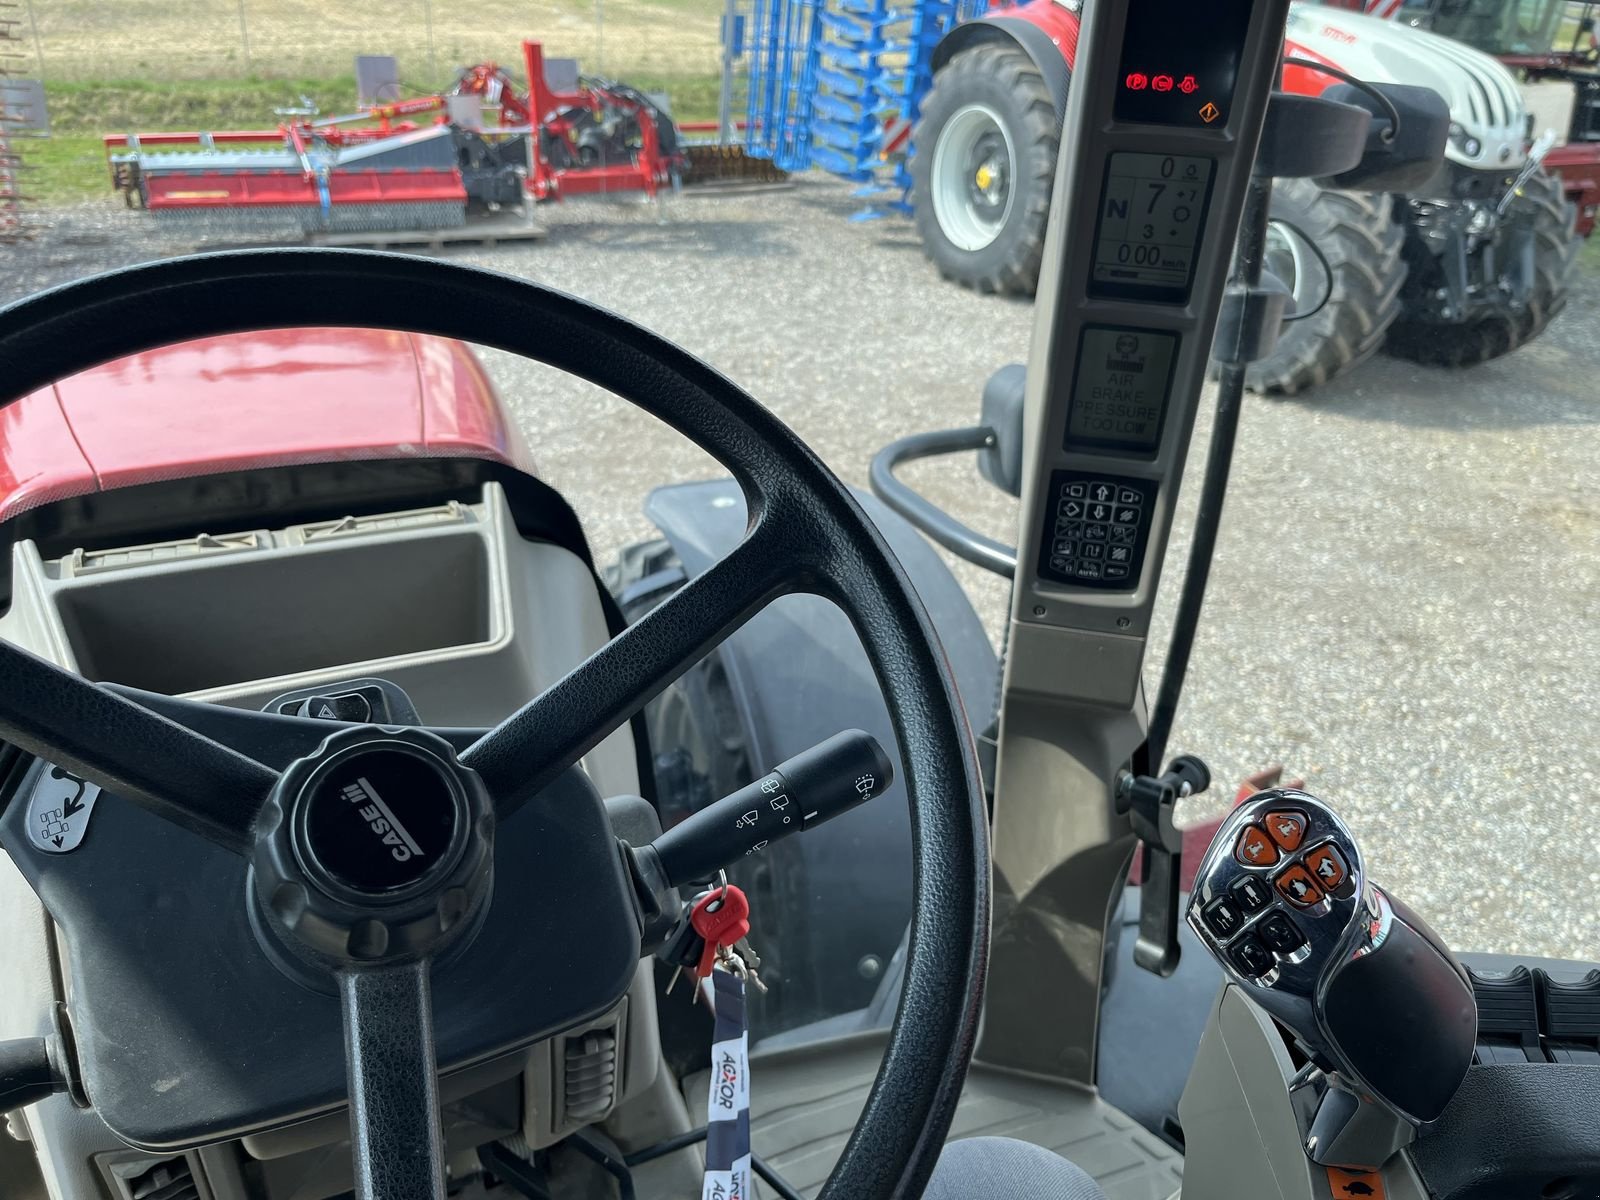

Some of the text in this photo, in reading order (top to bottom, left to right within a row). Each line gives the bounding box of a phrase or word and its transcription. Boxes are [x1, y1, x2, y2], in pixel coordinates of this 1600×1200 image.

[1161, 157, 1174, 178] 0
[1147, 183, 1166, 214] 7
[1106, 199, 1128, 219] N
[1143, 224, 1154, 239] 3
[1107, 372, 1135, 386] AIR
[1091, 386, 1145, 403] BRAKE
[1074, 400, 1158, 420] PRESSURE
[1081, 415, 1147, 434] TOO LOW
[1078, 569, 1098, 578] AUTO
[358, 804, 411, 861] CASE
